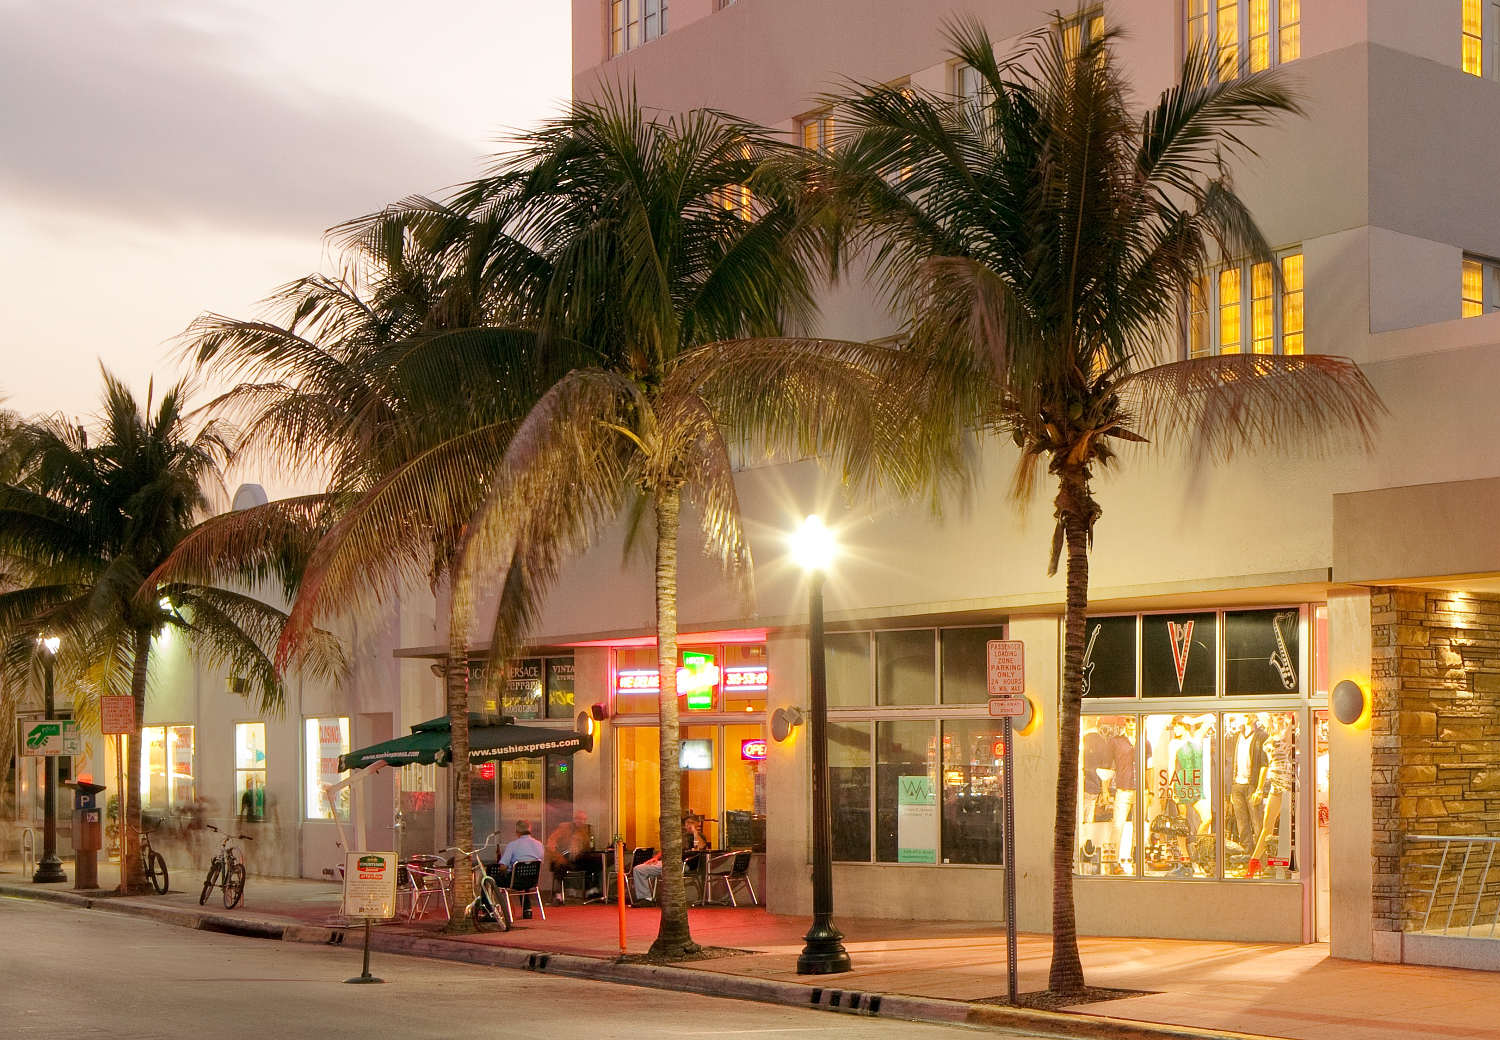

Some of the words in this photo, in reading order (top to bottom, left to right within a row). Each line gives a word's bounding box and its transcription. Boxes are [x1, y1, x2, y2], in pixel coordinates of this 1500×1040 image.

[990, 664, 1022, 672] PARKING
[996, 671, 1015, 679] ONLY
[1159, 769, 1201, 787] SALE
